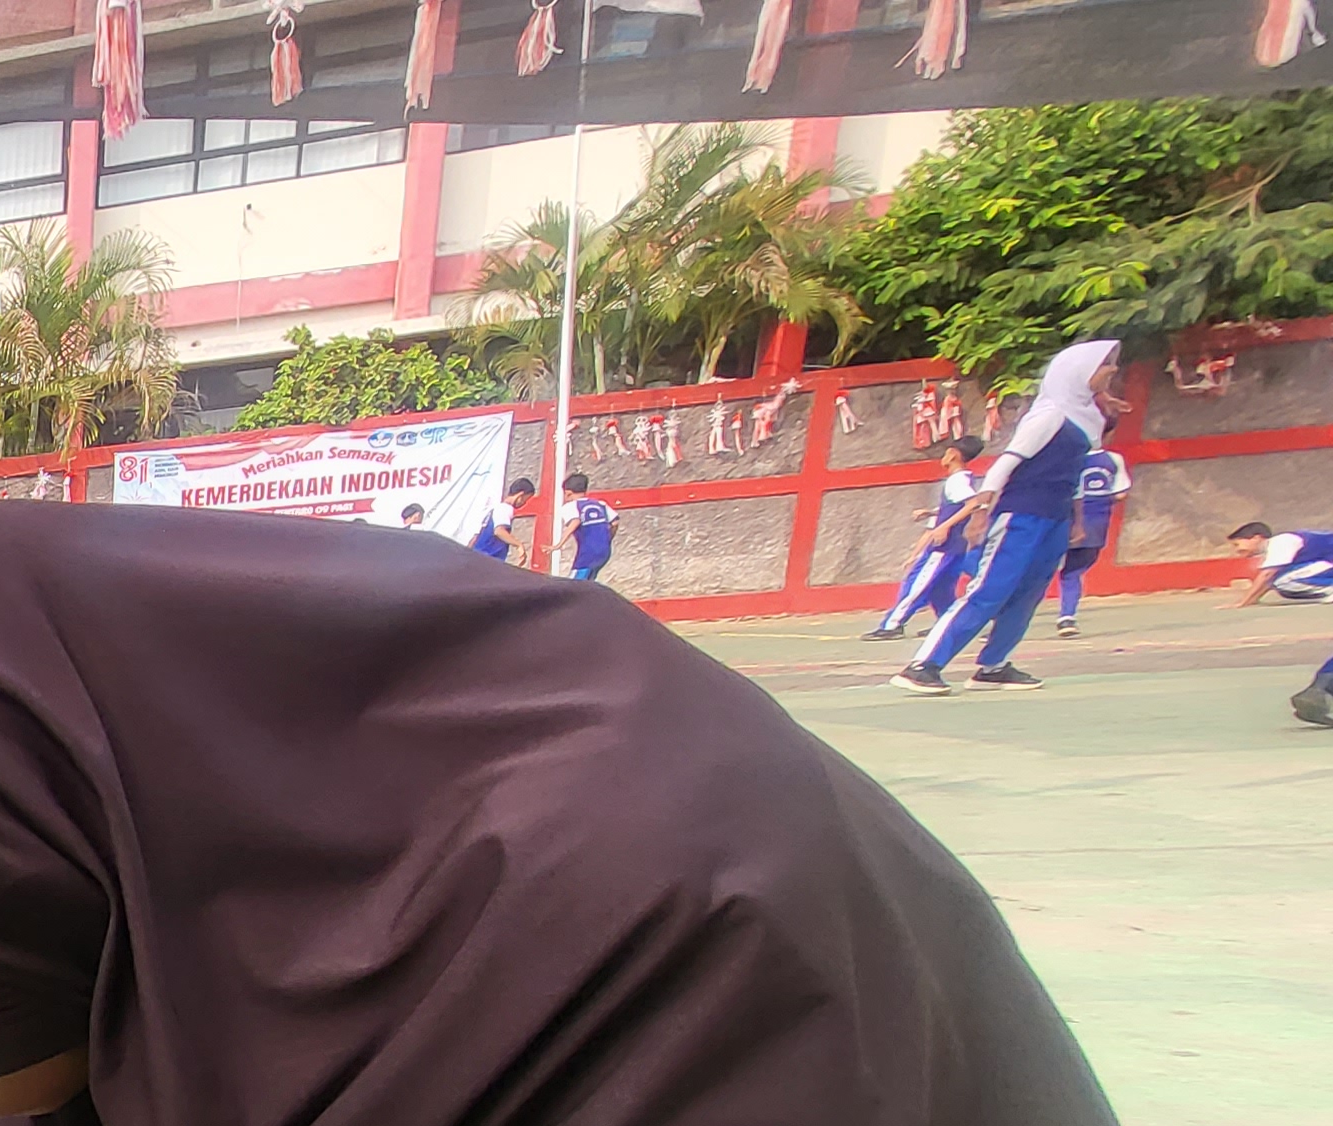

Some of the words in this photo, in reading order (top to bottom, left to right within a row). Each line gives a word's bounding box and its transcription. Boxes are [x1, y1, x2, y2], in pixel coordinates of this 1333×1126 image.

[241, 449, 323, 479] Meriahkan
[328, 446, 396, 465] Semarak
[181, 475, 333, 508] KEMERDEKAAN
[341, 463, 452, 494] INDONESIA
